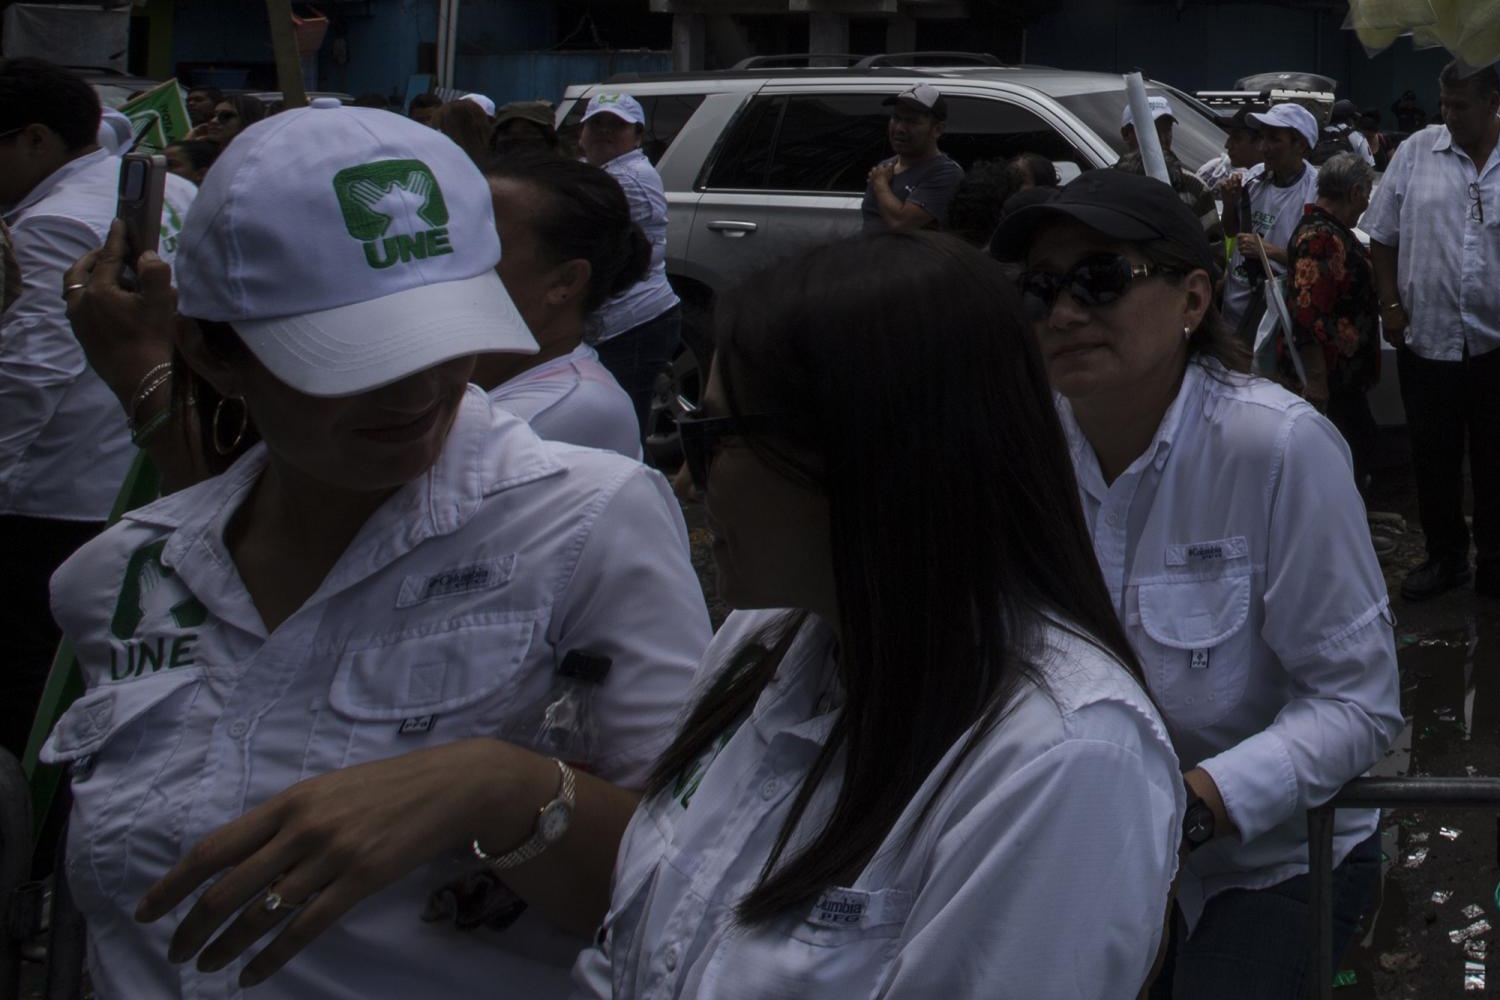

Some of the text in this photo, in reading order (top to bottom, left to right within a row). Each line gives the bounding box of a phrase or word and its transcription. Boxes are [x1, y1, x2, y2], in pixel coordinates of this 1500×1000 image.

[362, 227, 454, 269] UNE
[111, 634, 198, 681] UNE
[820, 911, 861, 924] PFG
